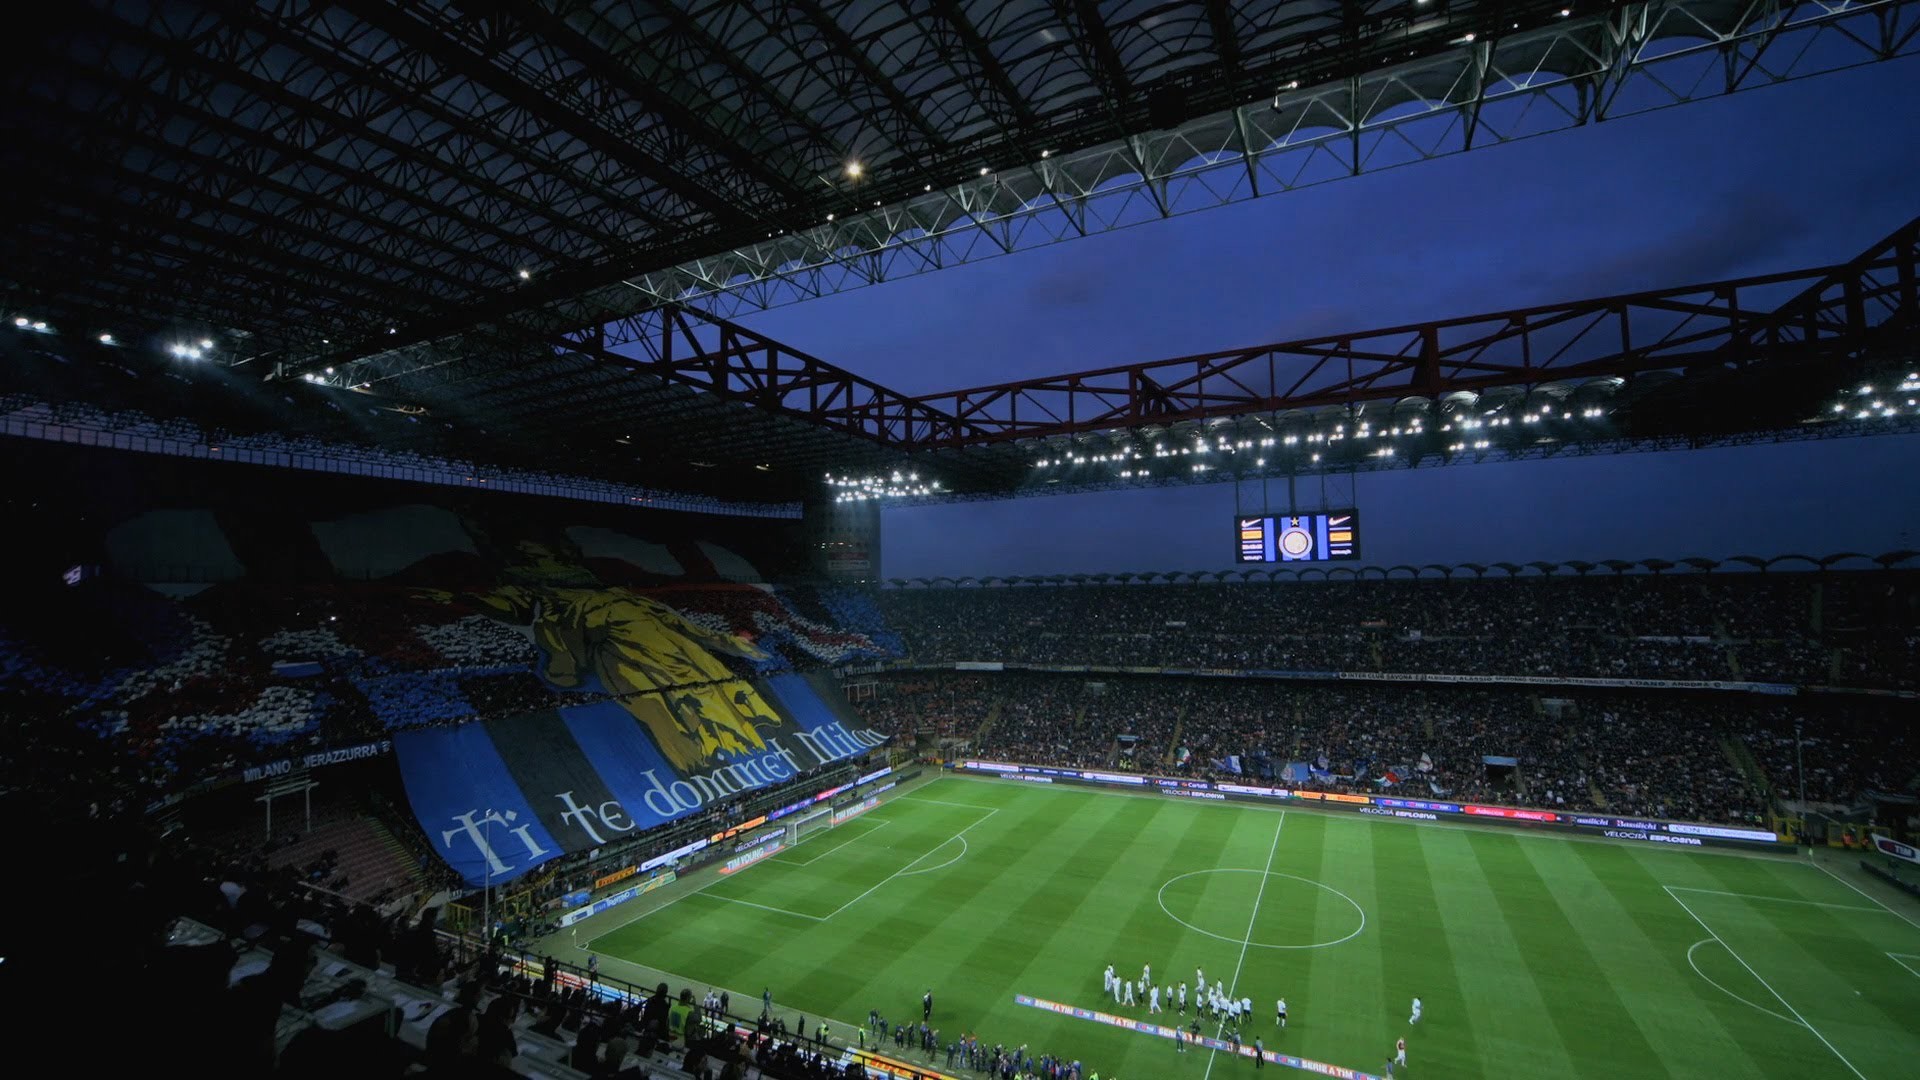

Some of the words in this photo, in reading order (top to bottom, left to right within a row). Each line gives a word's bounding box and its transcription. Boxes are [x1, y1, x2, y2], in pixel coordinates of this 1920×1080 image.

[243, 760, 292, 784] MILANO
[442, 809, 549, 877] Ti
[555, 791, 635, 844] te
[640, 737, 801, 816] dominet
[792, 721, 890, 764] Milan
